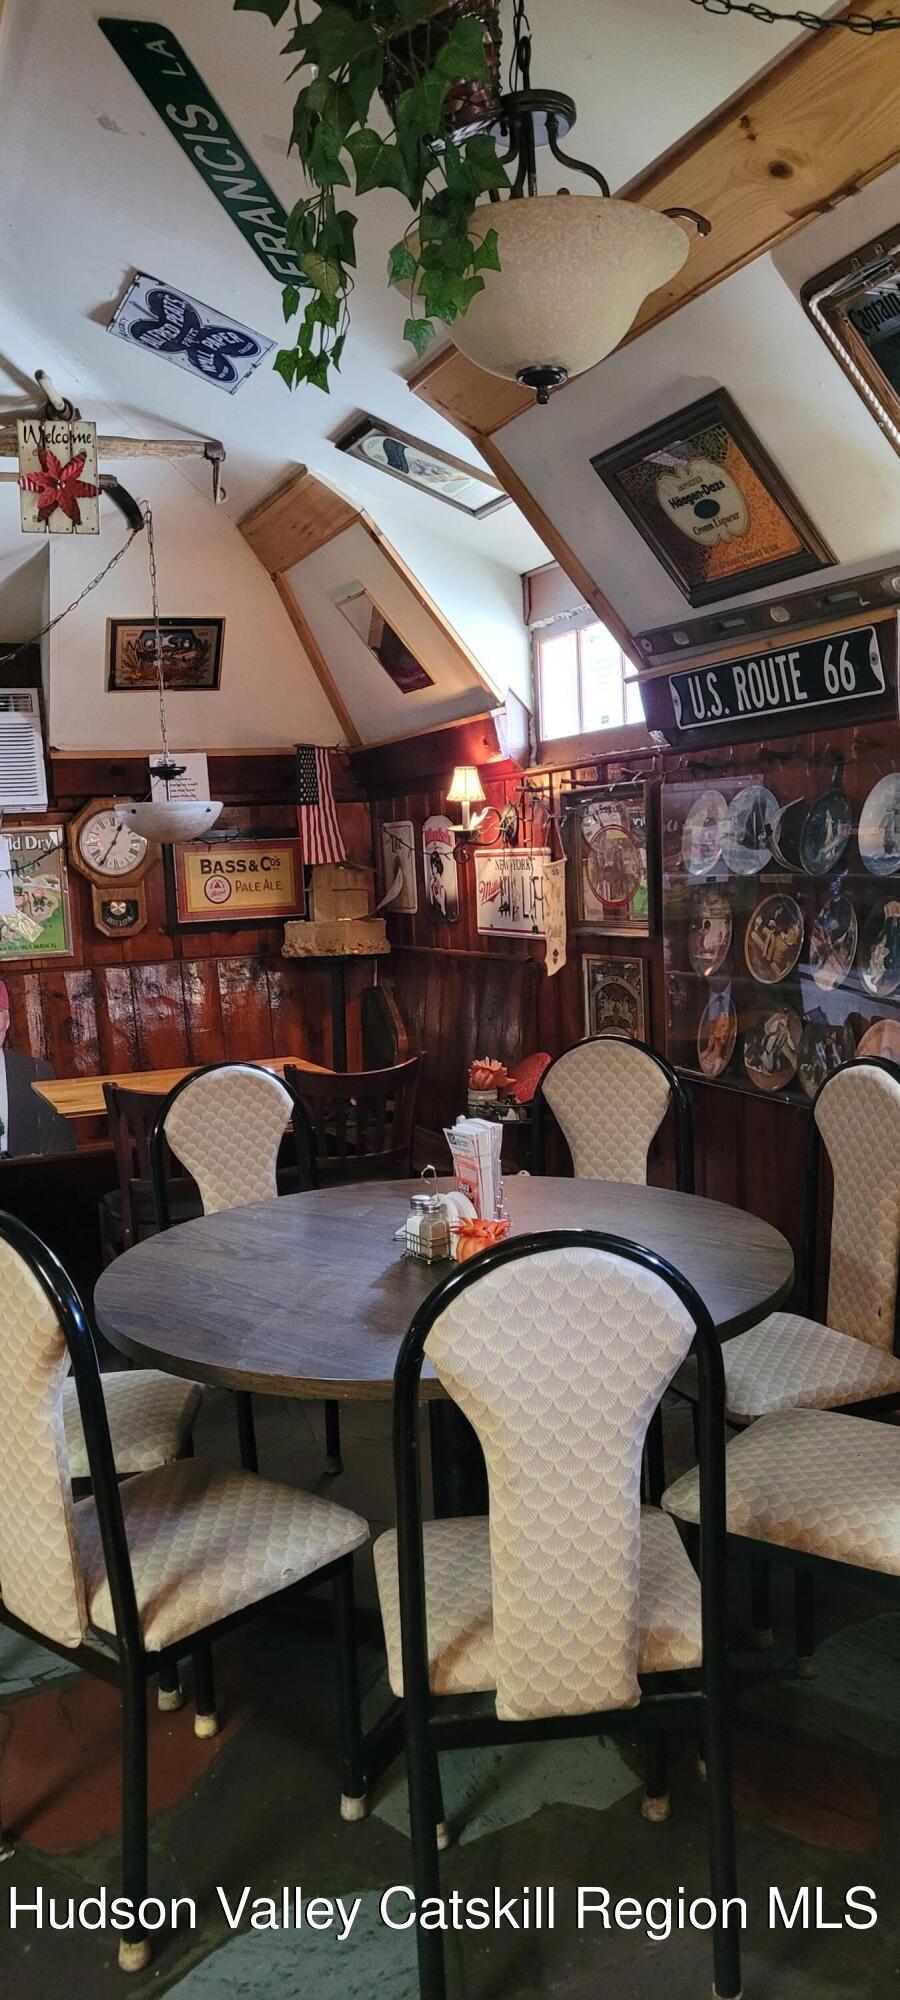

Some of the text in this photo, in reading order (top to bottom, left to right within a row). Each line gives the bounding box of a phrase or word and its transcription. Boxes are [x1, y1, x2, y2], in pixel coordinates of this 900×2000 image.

[144, 39, 307, 278] FRANCIS LA
[848, 290, 900, 336] Captain
[139, 323, 181, 349] ALFRED
[200, 331, 245, 351] PAPER
[23, 424, 93, 444] Welcome
[687, 640, 856, 720] U.S. ROUTE 66
[25, 835, 53, 852] Dry
[494, 858, 531, 871] NEW YORK
[235, 880, 262, 893] PALE
[263, 878, 282, 891] ALE
